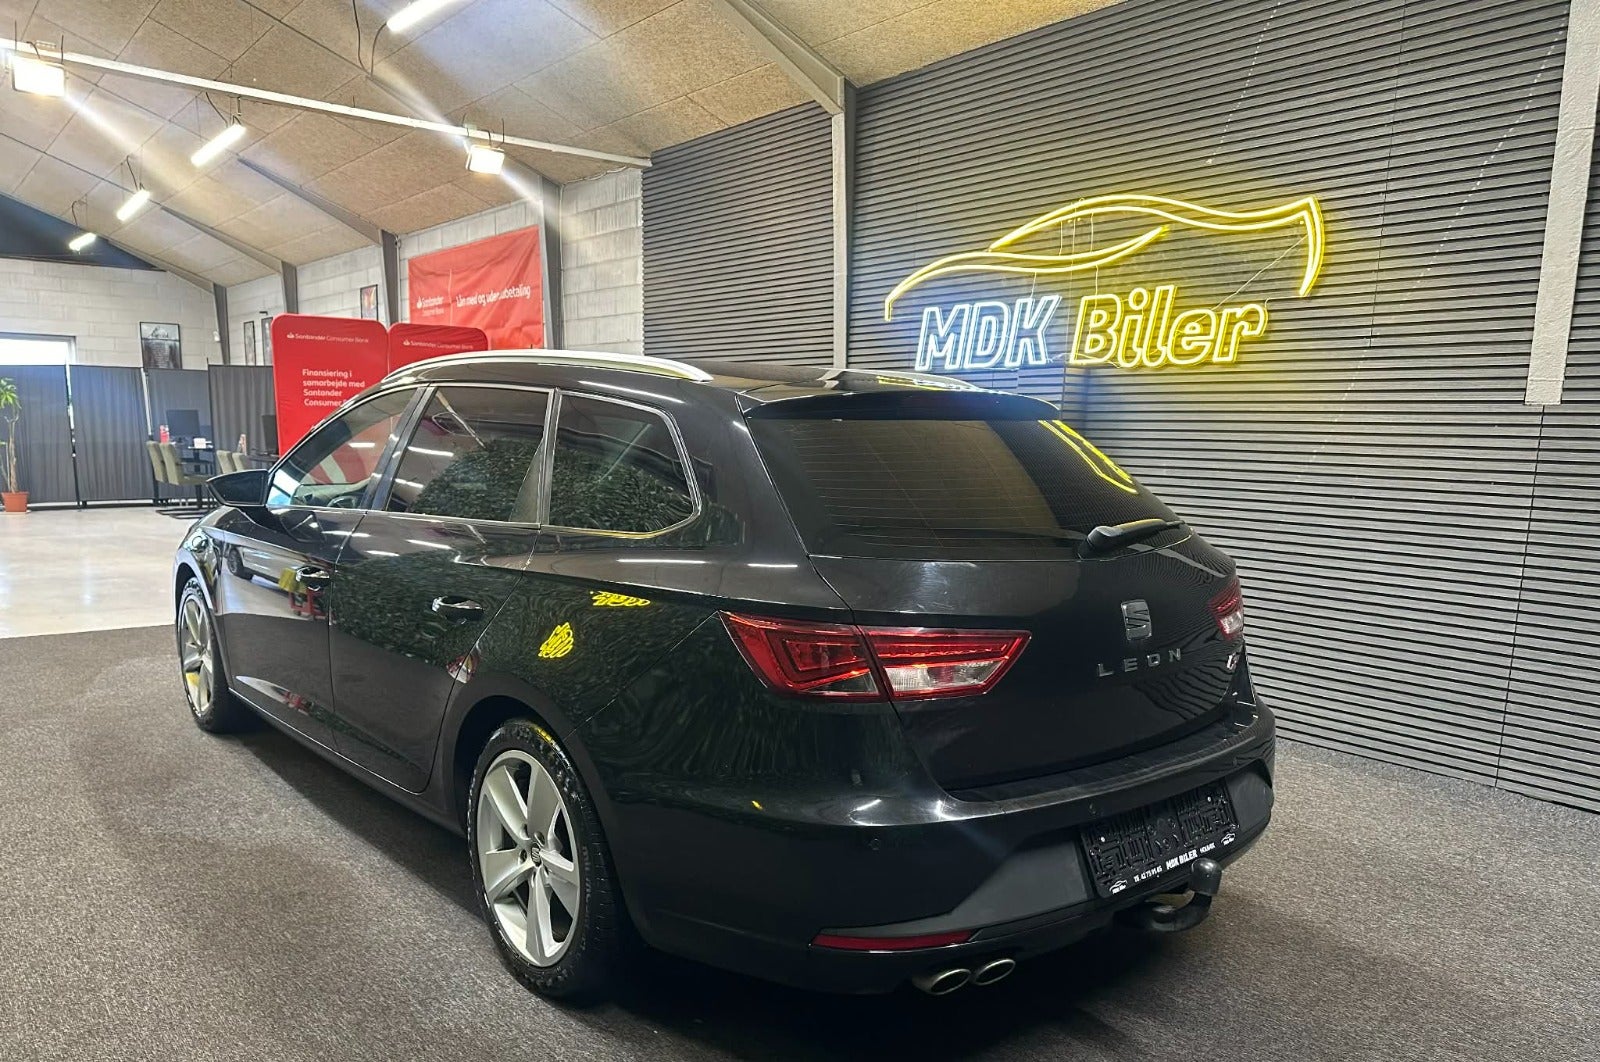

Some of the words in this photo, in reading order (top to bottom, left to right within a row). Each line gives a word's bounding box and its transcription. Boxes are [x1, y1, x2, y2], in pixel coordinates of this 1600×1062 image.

[915, 294, 1062, 372] MDK
[1068, 284, 1268, 368] Biler
[295, 333, 326, 341] Santander
[302, 368, 348, 379] Finansiering
[302, 379, 347, 389] samarbejde
[303, 388, 343, 397] Santander
[304, 398, 341, 407] Consumer
[1097, 647, 1181, 677] LEON
[1165, 857, 1180, 870] MDK
[1179, 849, 1198, 865] BILER
